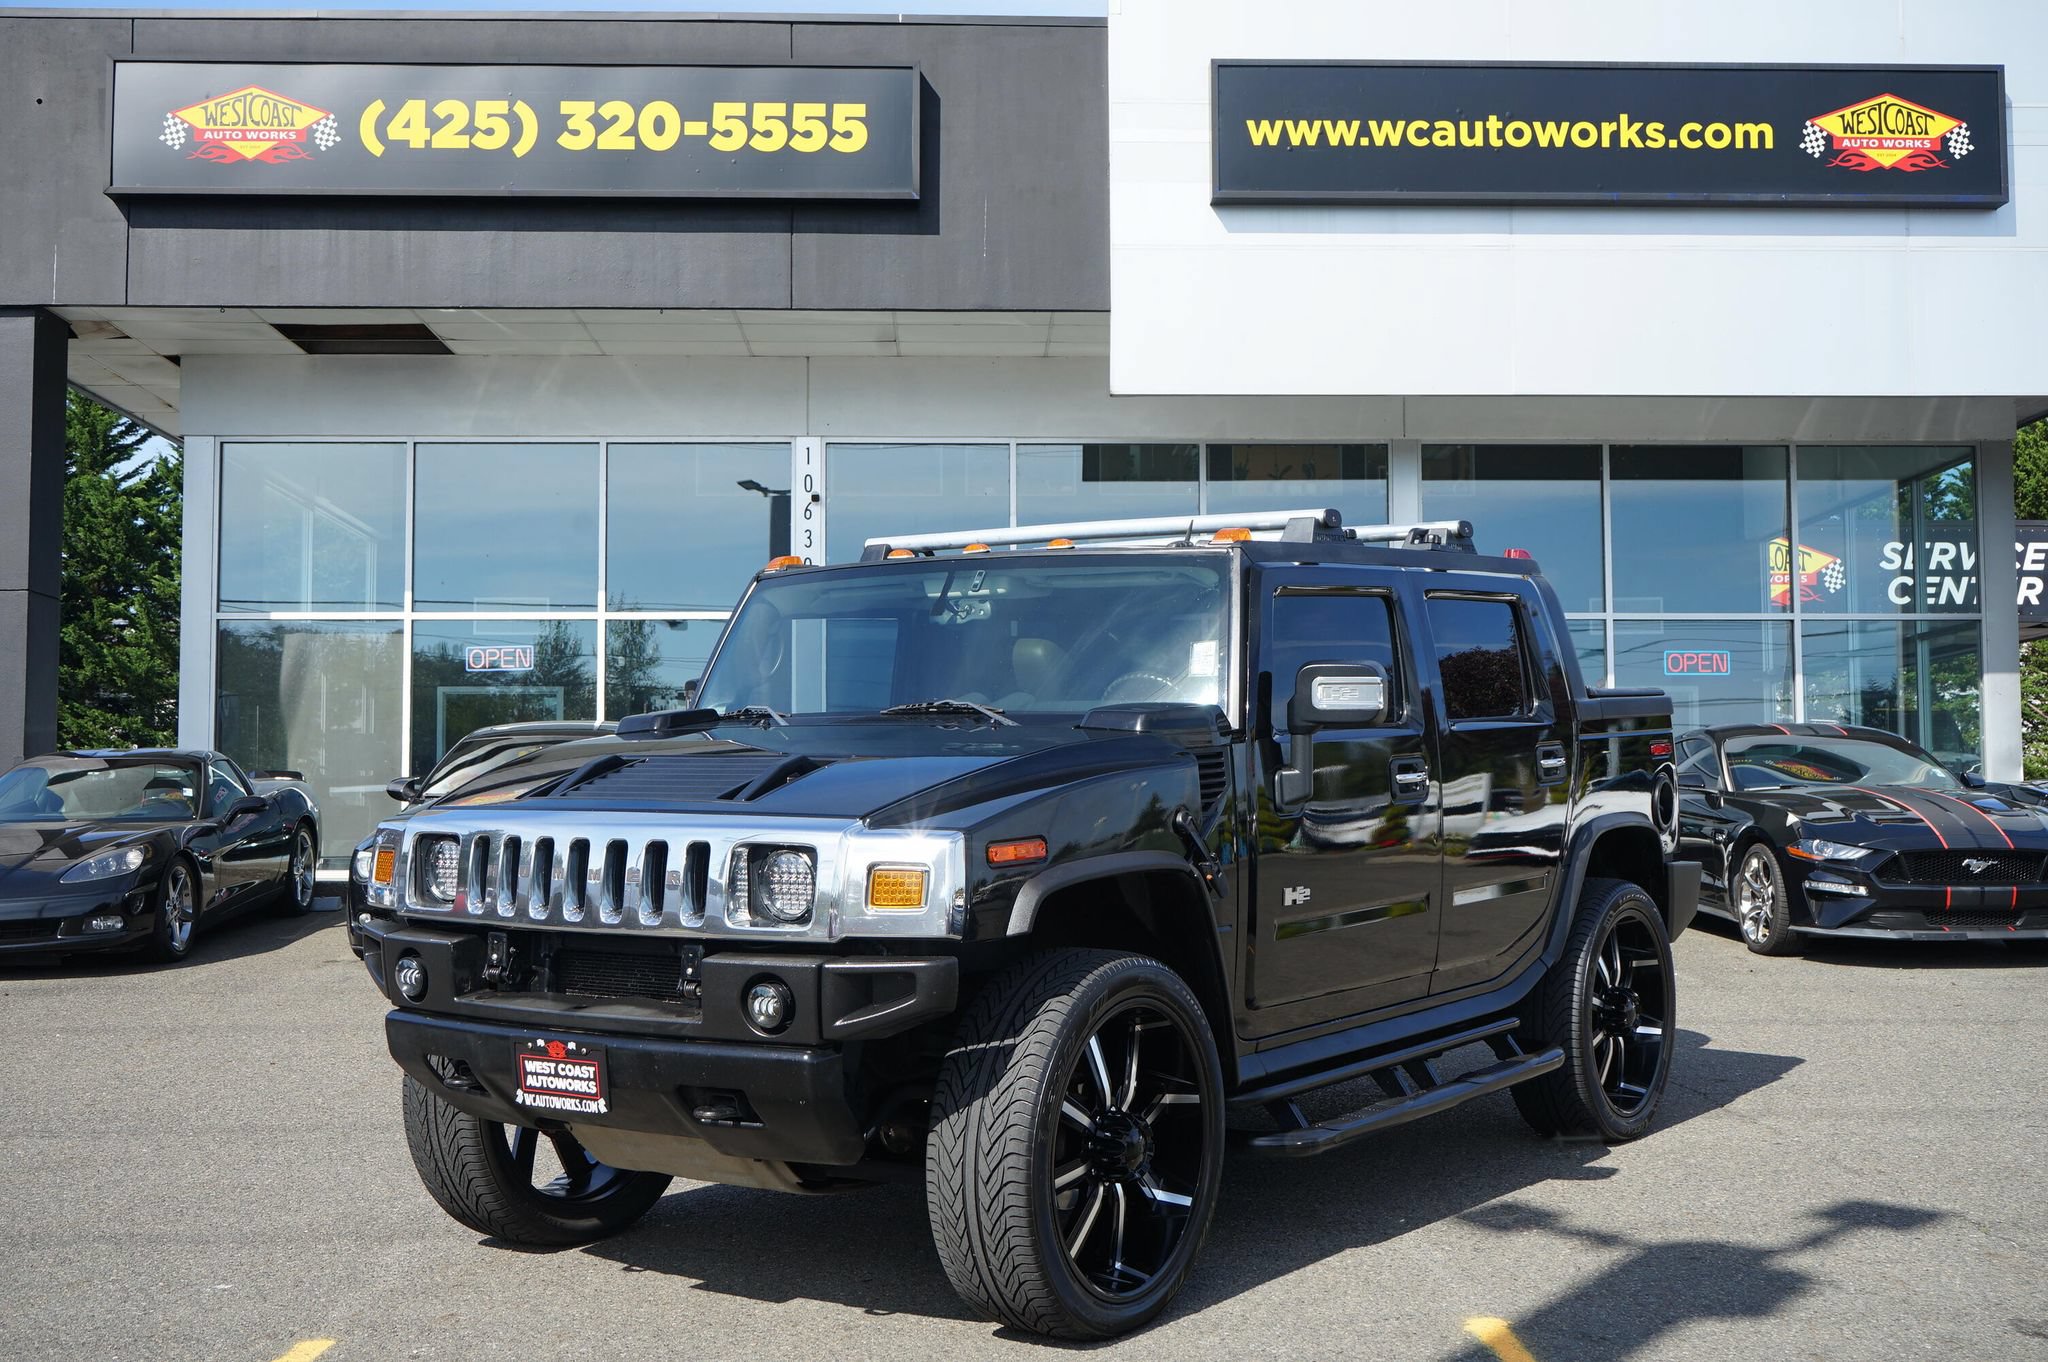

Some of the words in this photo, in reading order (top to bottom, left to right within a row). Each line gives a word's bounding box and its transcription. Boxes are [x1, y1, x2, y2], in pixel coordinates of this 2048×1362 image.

[203, 130, 242, 140] AUTO
[245, 131, 297, 141] WORKS
[360, 99, 539, 158] (425)
[557, 100, 869, 153] 320-5555
[1247, 113, 1774, 150] www.wcautoworks.com
[1842, 138, 1879, 148] AUTO
[1882, 139, 1931, 149] WORKS
[1879, 541, 2048, 571] SRVE
[1887, 575, 2044, 605] CENR
[469, 648, 530, 669] OPEN
[1667, 653, 1727, 673] OPEN
[1283, 885, 1311, 906] H2
[524, 1060, 556, 1074] WEST
[557, 1063, 596, 1079] COAST
[526, 1074, 597, 1094] AUTOWORKS
[523, 1093, 598, 1113] WCAUTOWORKS.COM
